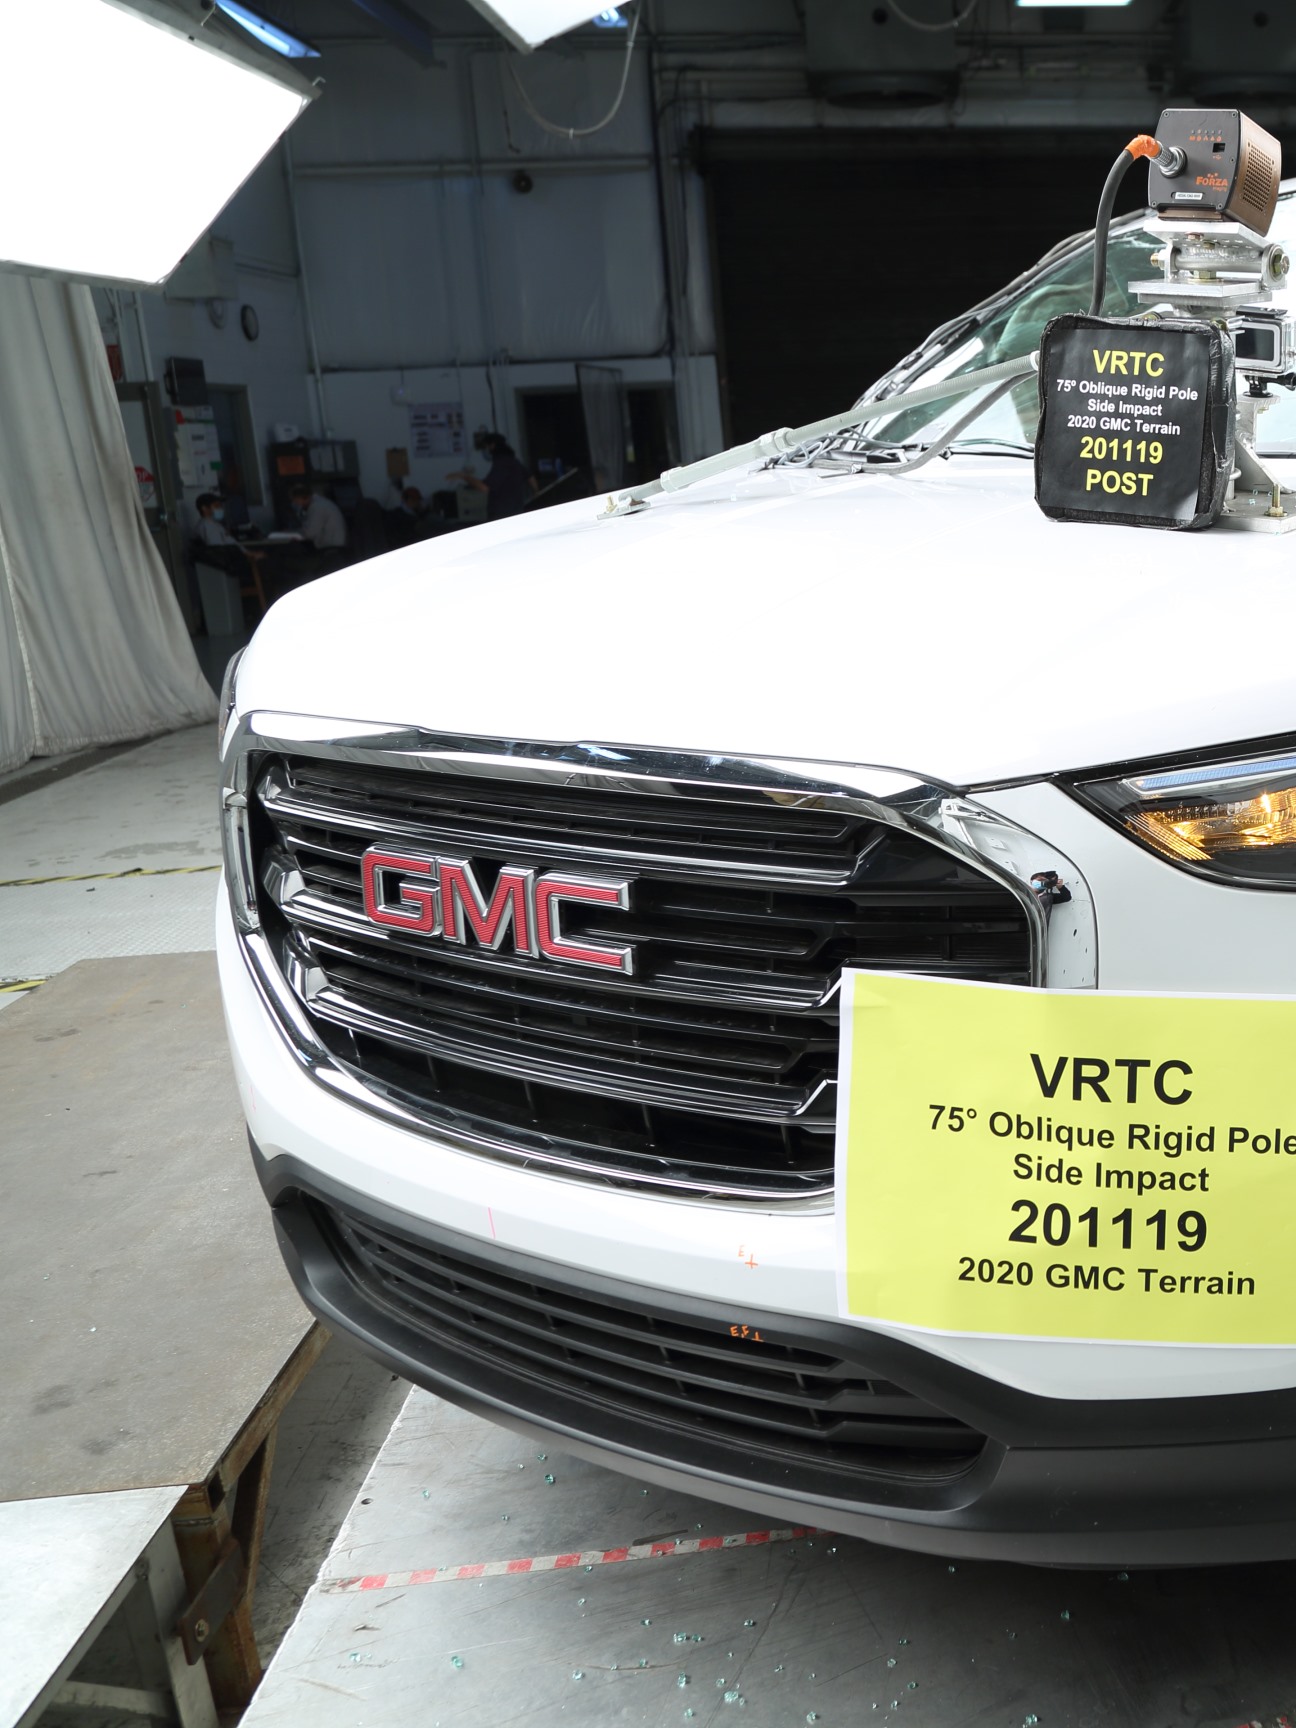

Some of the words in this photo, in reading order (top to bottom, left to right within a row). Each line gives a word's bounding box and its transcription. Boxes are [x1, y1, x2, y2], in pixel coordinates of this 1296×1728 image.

[1092, 349, 1165, 378] VRTC
[1079, 380, 1129, 398] Oblique
[1131, 384, 1166, 401] Rigid
[1168, 386, 1199, 401] Pole
[1087, 398, 1116, 413] Side
[1118, 401, 1163, 418] Impact
[1067, 415, 1097, 429] 2020
[1099, 417, 1132, 432] GMC
[1134, 419, 1181, 436] Terrain
[1079, 436, 1163, 465] 201119
[1085, 469, 1154, 497] POST
[361, 846, 634, 976] GMC
[1029, 1053, 1193, 1106] VRTC
[989, 1111, 1115, 1152] Oblique
[1128, 1123, 1215, 1158] Rigid
[1013, 1154, 1083, 1186] Side
[1095, 1162, 1210, 1196] Impact
[1008, 1199, 1207, 1253] 201119
[958, 1256, 1034, 1286] 2020
[1045, 1263, 1125, 1292] GMC
[1137, 1268, 1255, 1295] Terrain
